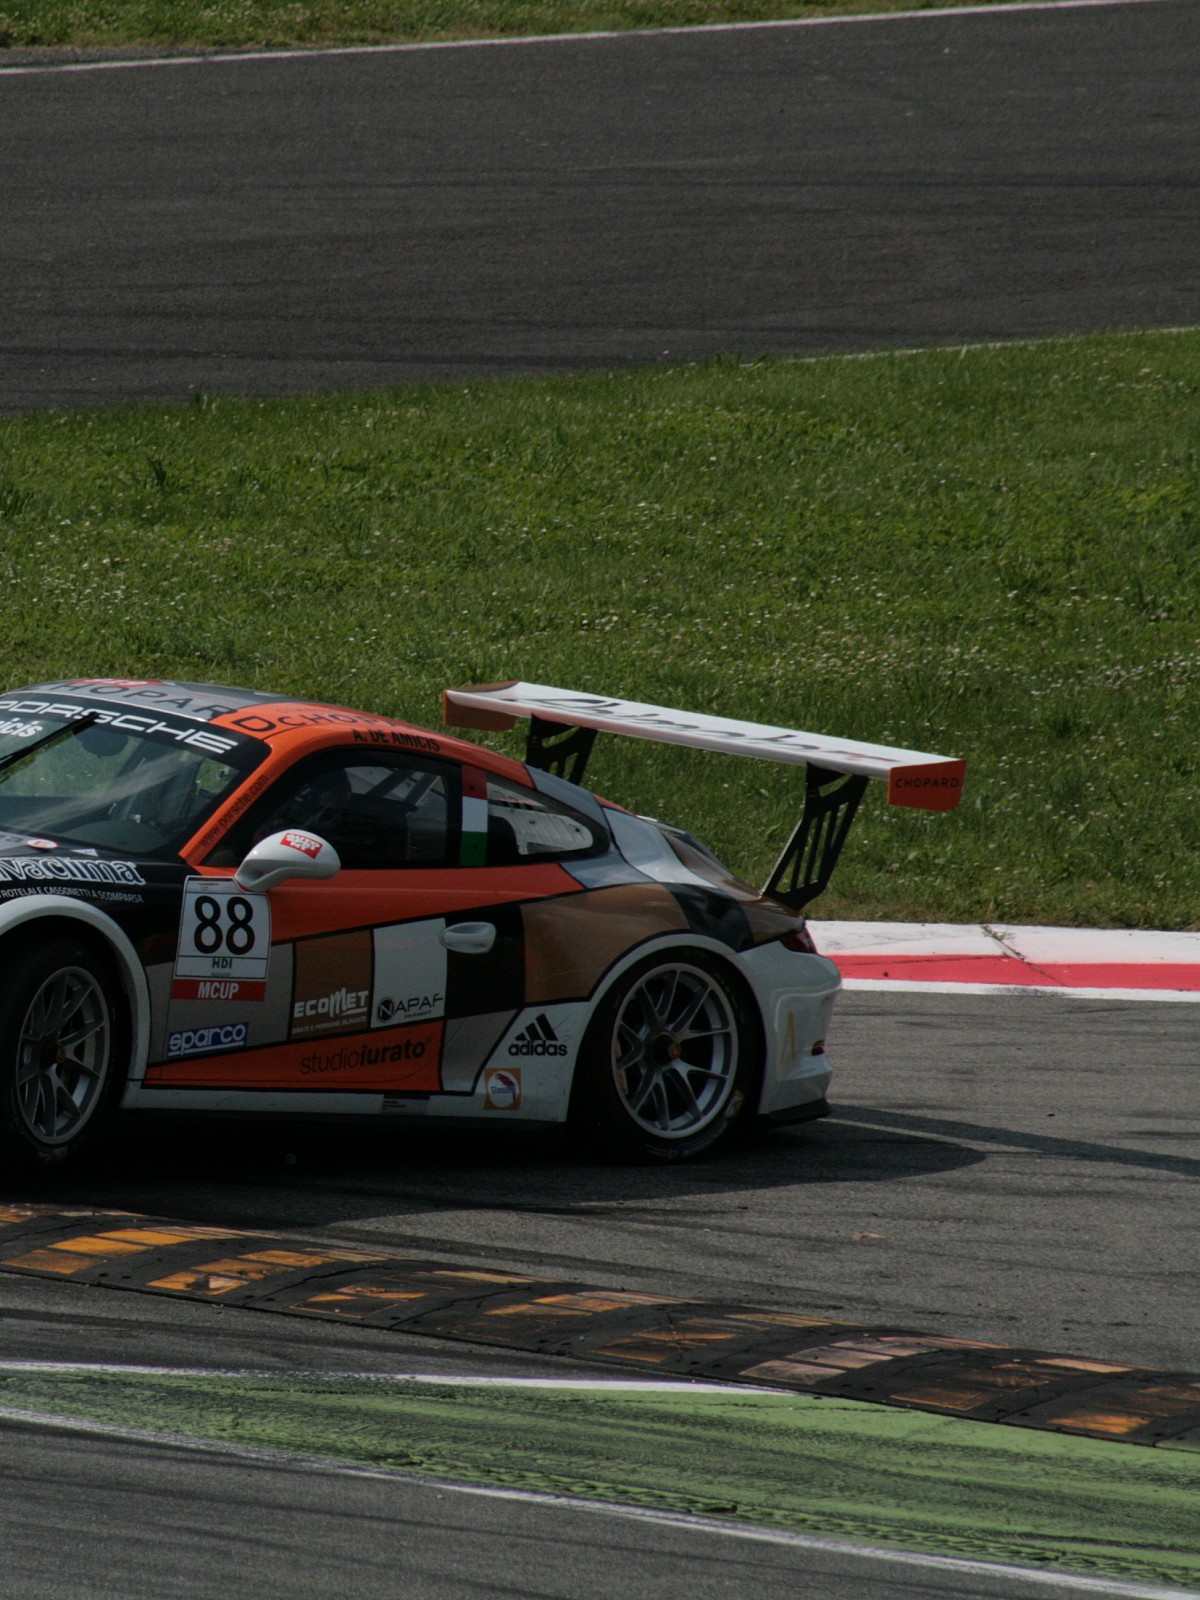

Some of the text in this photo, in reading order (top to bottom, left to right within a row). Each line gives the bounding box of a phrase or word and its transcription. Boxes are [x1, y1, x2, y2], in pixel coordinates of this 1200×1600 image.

[371, 730, 388, 744] DE
[392, 731, 441, 751] AMICIS
[895, 777, 960, 789] CHOPARD
[200, 775, 269, 848] www.porsche.com
[194, 895, 255, 955] 88
[212, 957, 233, 969] HDI
[198, 981, 239, 999] MCUP
[168, 1024, 246, 1056] sparco
[508, 1040, 568, 1056] adidas
